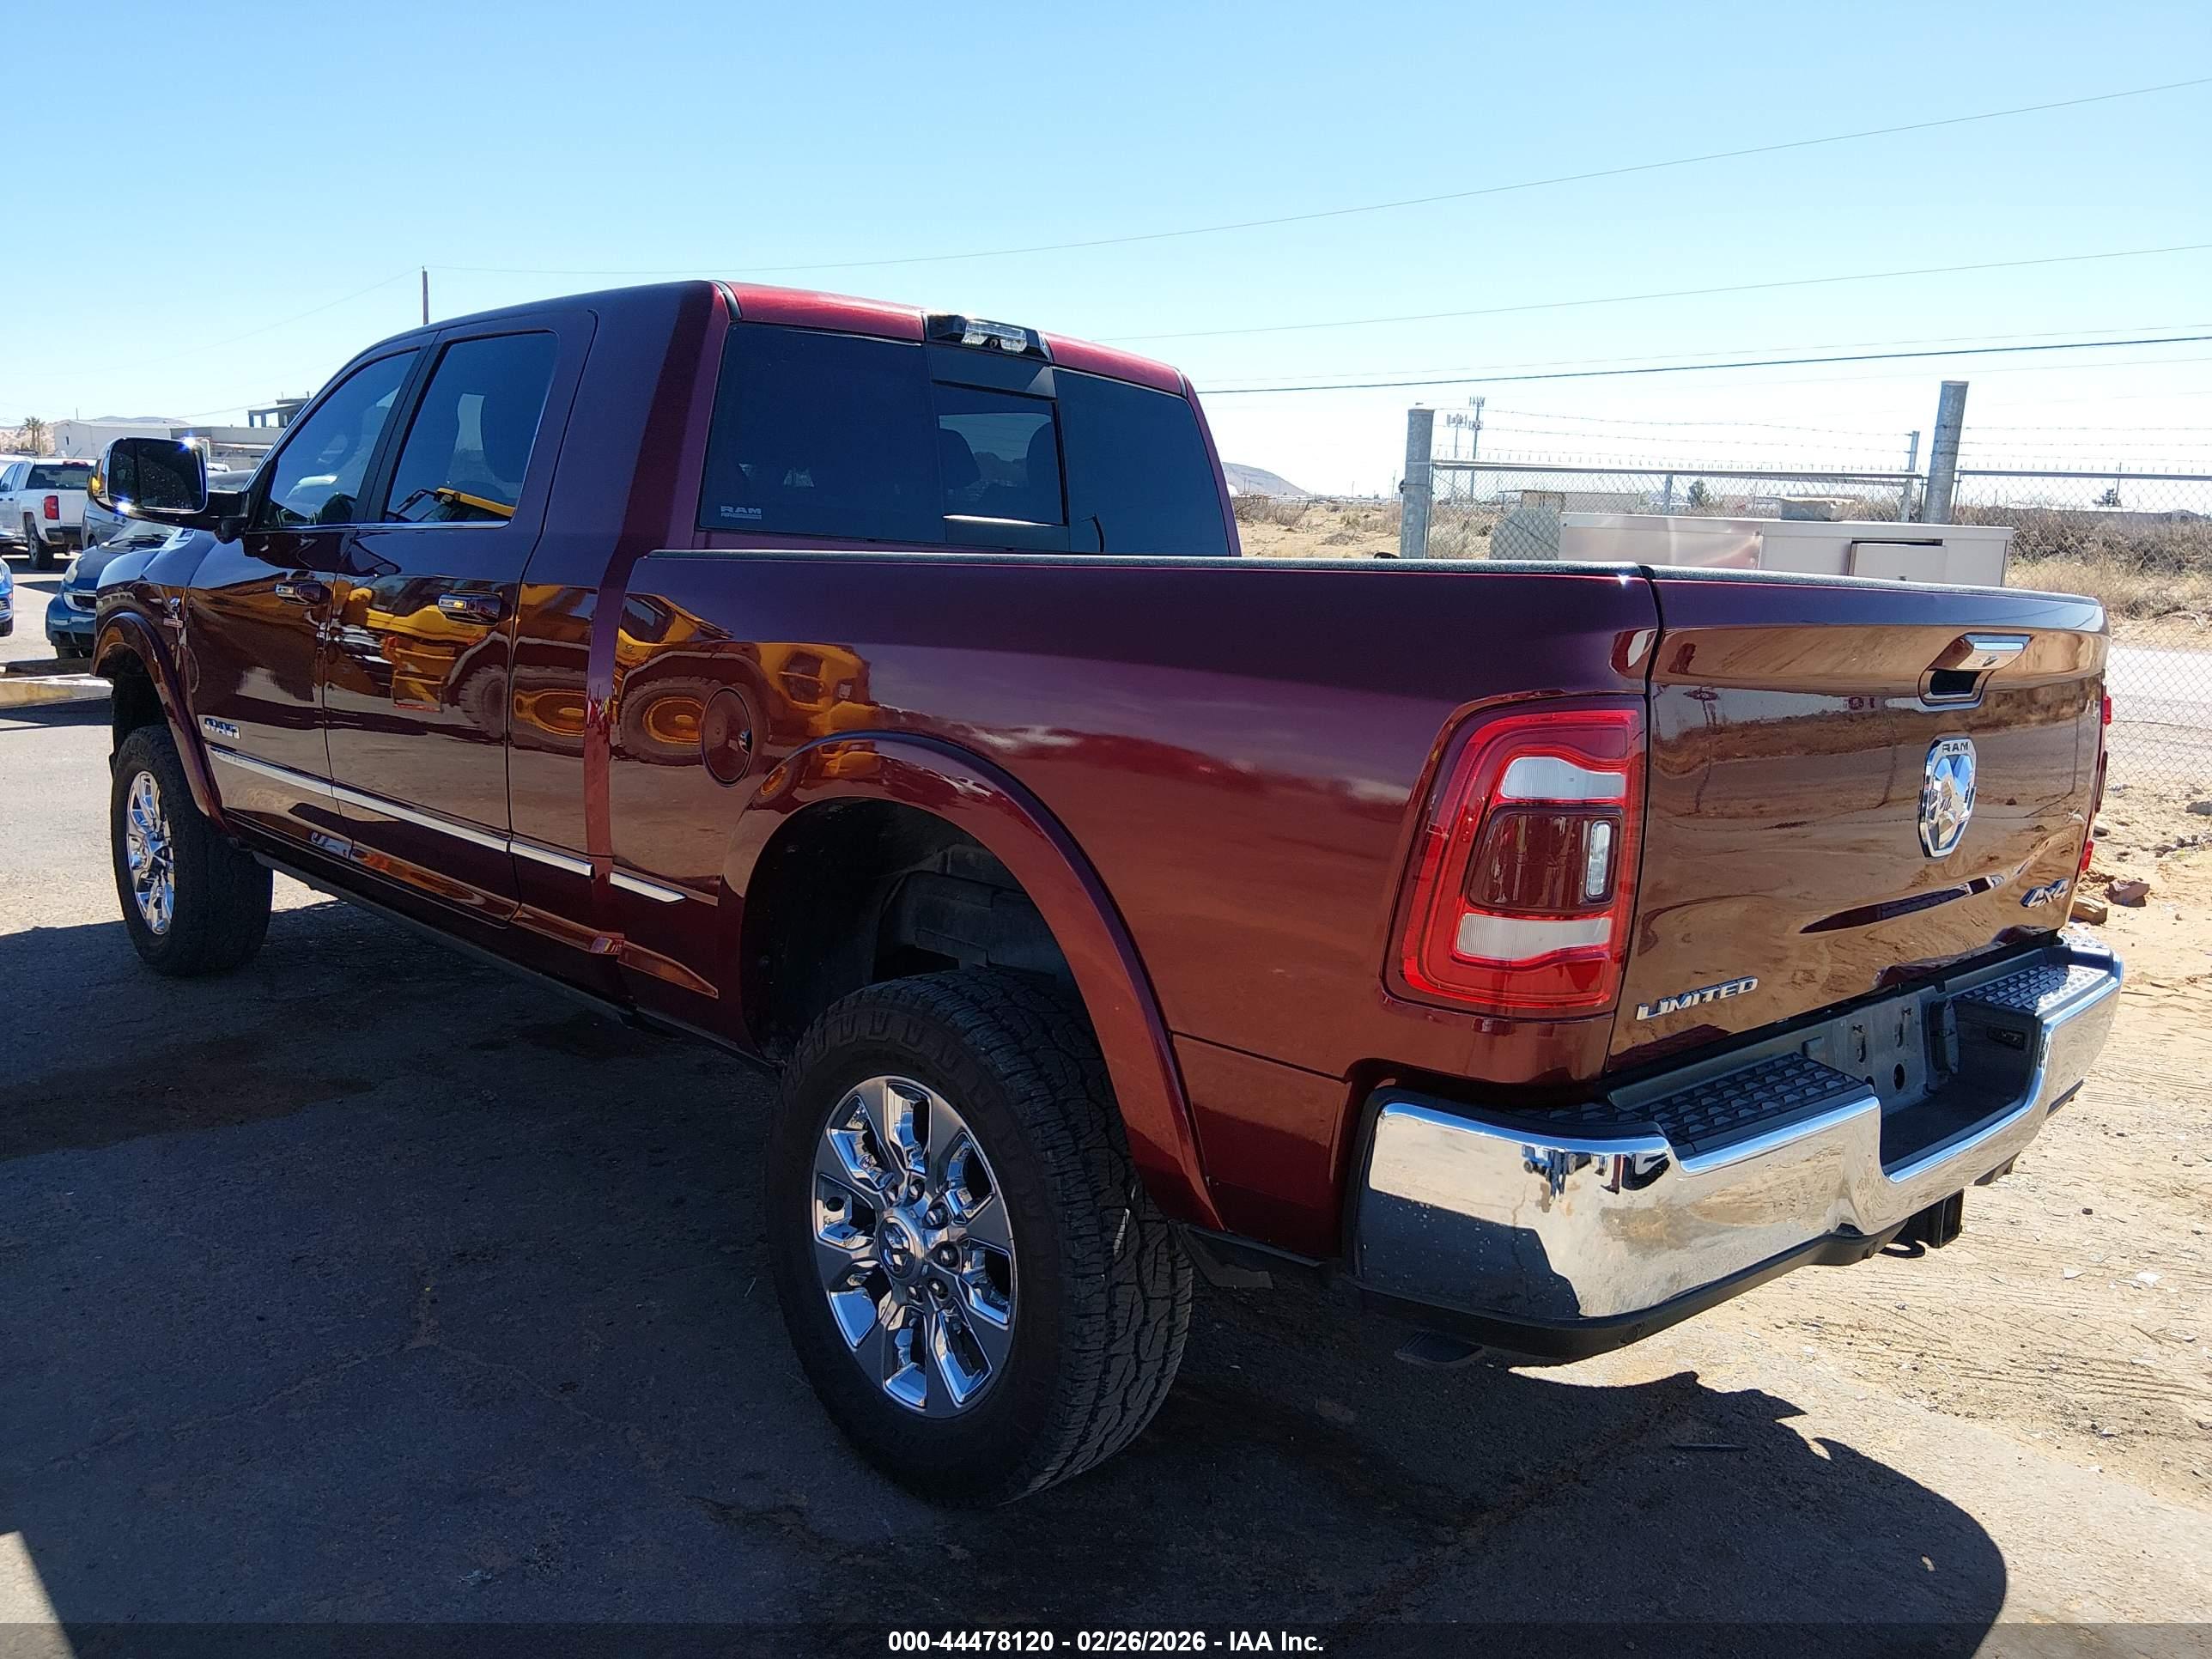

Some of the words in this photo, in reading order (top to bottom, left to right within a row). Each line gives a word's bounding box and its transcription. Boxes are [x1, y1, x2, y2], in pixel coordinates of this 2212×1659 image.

[720, 505, 762, 514] RAM
[1942, 742, 1969, 753] RAM
[1636, 975, 1759, 1021] LIMITED
